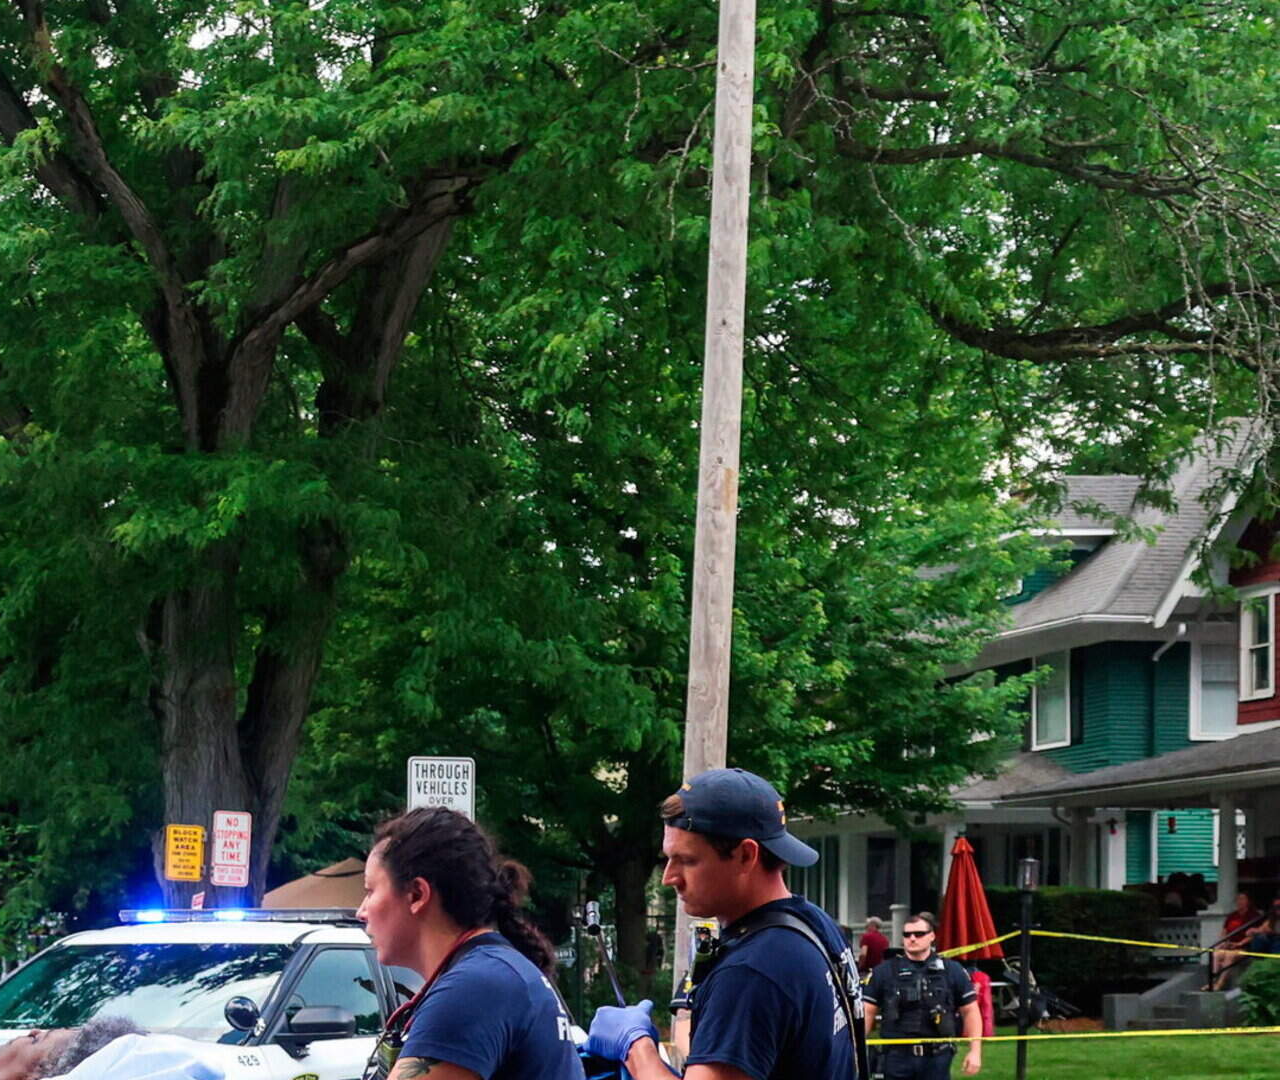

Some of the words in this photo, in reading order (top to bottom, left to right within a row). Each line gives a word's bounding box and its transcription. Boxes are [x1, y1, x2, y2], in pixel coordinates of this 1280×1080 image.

[415, 763, 470, 780] THROUGH
[416, 781, 468, 796] VEHICLES
[428, 796, 455, 806] OVER
[227, 818, 240, 828] NO
[223, 841, 240, 850] ANY
[222, 851, 241, 861] TIME
[237, 1055, 261, 1067] 429
